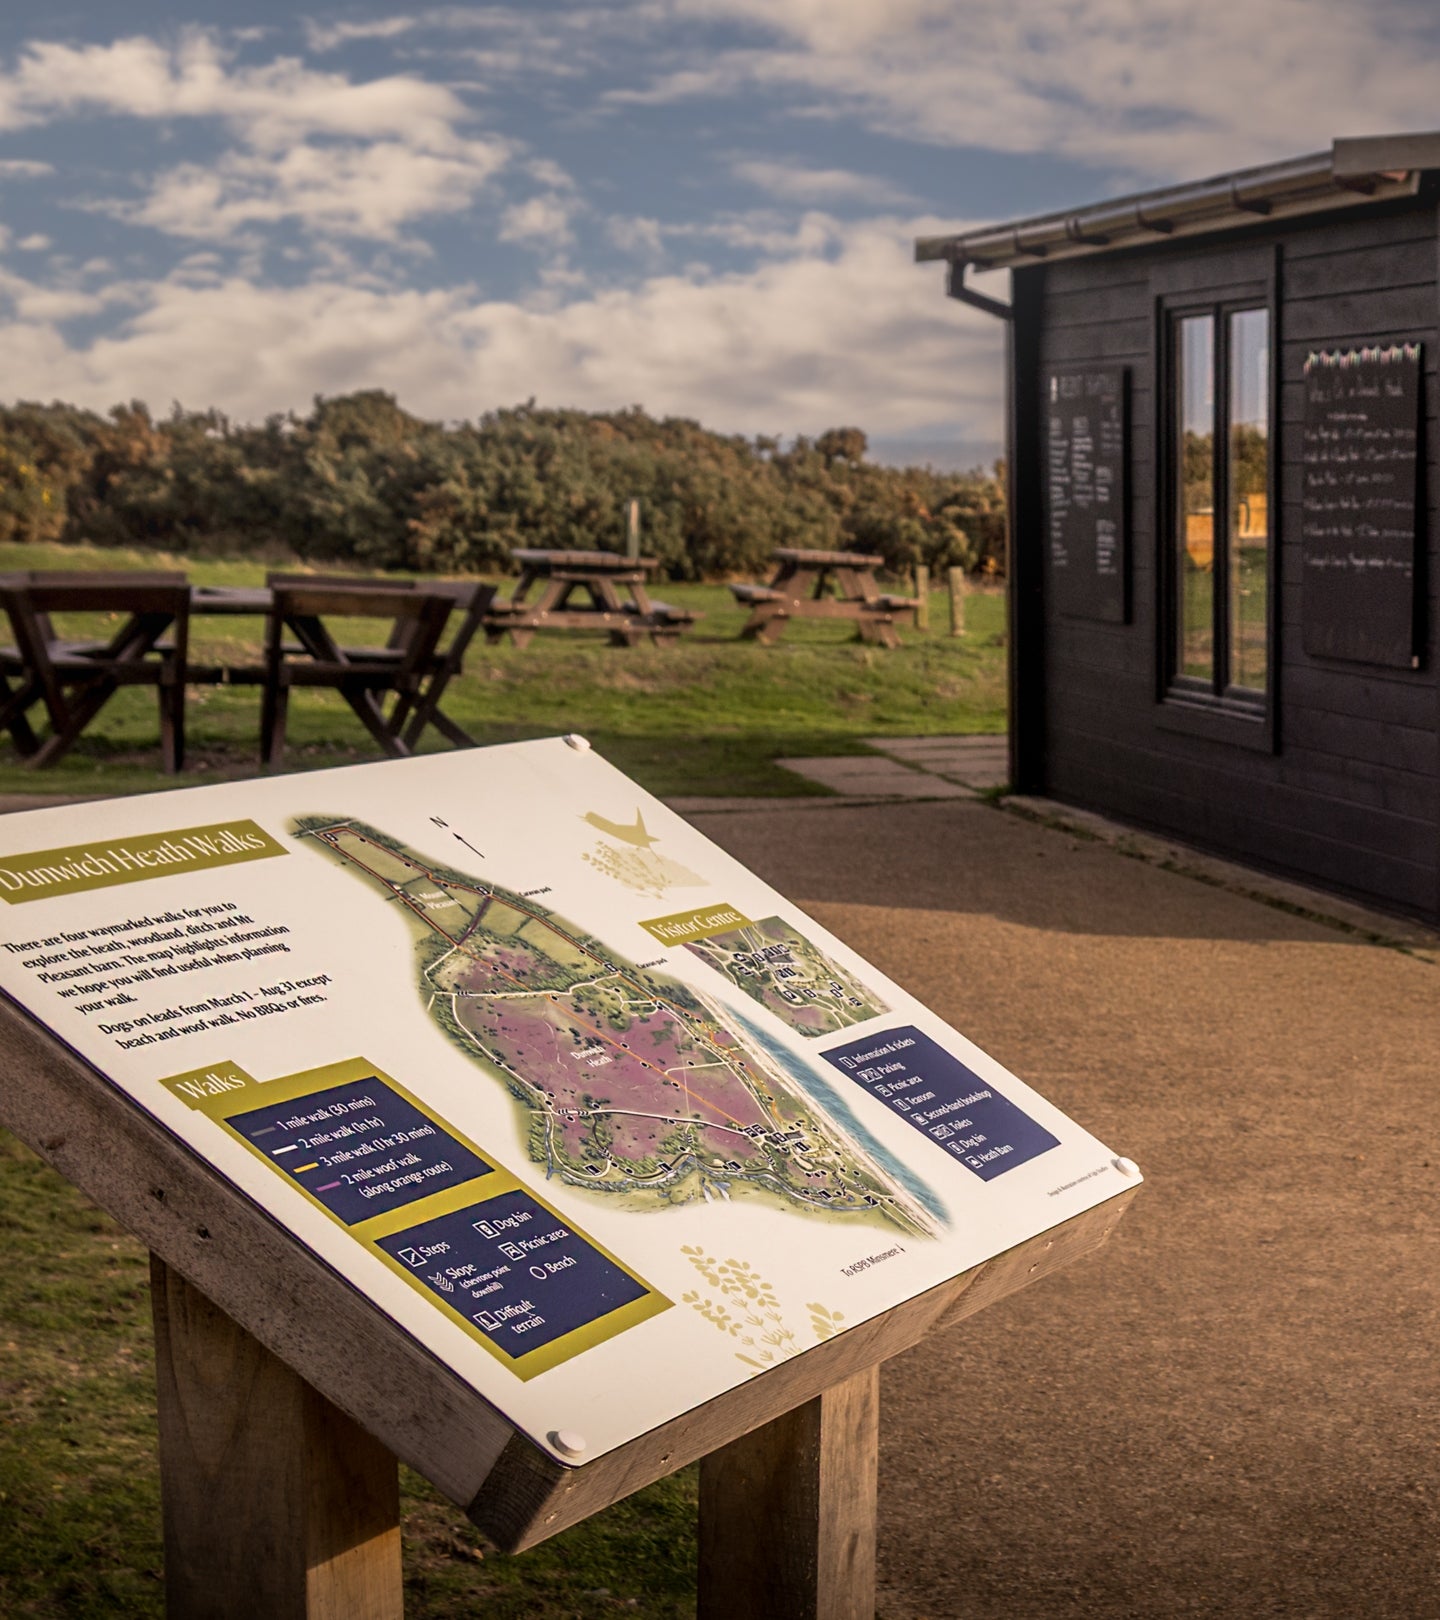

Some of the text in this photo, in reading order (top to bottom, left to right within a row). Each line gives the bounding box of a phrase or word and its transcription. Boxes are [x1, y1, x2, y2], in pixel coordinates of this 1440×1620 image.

[429, 816, 449, 828] N
[0, 830, 266, 891] Dunwich Heath Walks
[1, 902, 237, 953] There are four waymarked walks for you to
[650, 911, 741, 939] Visitor Centre
[22, 914, 255, 968] explore the heath, woodland, ditch and Mt
[36, 925, 290, 984] Pleasant barn. The map highlights information
[57, 943, 291, 999] we hope you will find useful when planning
[74, 992, 138, 1015] your walk.
[97, 1021, 135, 1035] Dogs
[133, 1015, 153, 1027] on
[147, 1008, 183, 1023] leads
[178, 1002, 211, 1016] from
[206, 993, 243, 1009] March
[242, 991, 254, 1000] 1
[259, 984, 286, 996] Aug
[278, 981, 297, 992] 31
[295, 974, 333, 989] except
[114, 993, 328, 1050] beach and woof walk. No BBQs or fires.
[570, 1044, 606, 1060] Dunwich
[586, 1055, 613, 1068] Heath
[851, 1047, 889, 1063] Information
[893, 1038, 916, 1050] tickets
[877, 1062, 906, 1074] Parking
[176, 1073, 246, 1100] Walks
[887, 1076, 923, 1091] Picnic area
[904, 1091, 936, 1105] Tearoom
[923, 1090, 992, 1120] Second-hand bookshop
[276, 1095, 376, 1130] 1 mile walk (30 mins)
[948, 1118, 973, 1131] Toilets
[297, 1138, 312, 1149] 2
[309, 1133, 333, 1146] mile
[330, 1125, 356, 1139] walk
[364, 1116, 385, 1128] hr)
[959, 1133, 987, 1148] Dog bin
[319, 1124, 436, 1166] 3 mile walk (1 hr 30 mins)
[977, 1144, 1014, 1163] Heath Barn
[340, 1152, 422, 1184] 2 mile woof walk
[358, 1160, 454, 1199] (along orange route)
[492, 1210, 533, 1230] Dog bin
[418, 1241, 451, 1257] Steps
[517, 1229, 569, 1252] Picnic area
[445, 1263, 478, 1279] Slope
[543, 1255, 578, 1273] Bench
[840, 1248, 900, 1277] To RSPB Minsmere
[458, 1264, 511, 1290] (chevrons point
[471, 1281, 504, 1298] downhill)
[493, 1299, 536, 1321] Difficult
[511, 1315, 546, 1334] terrain
